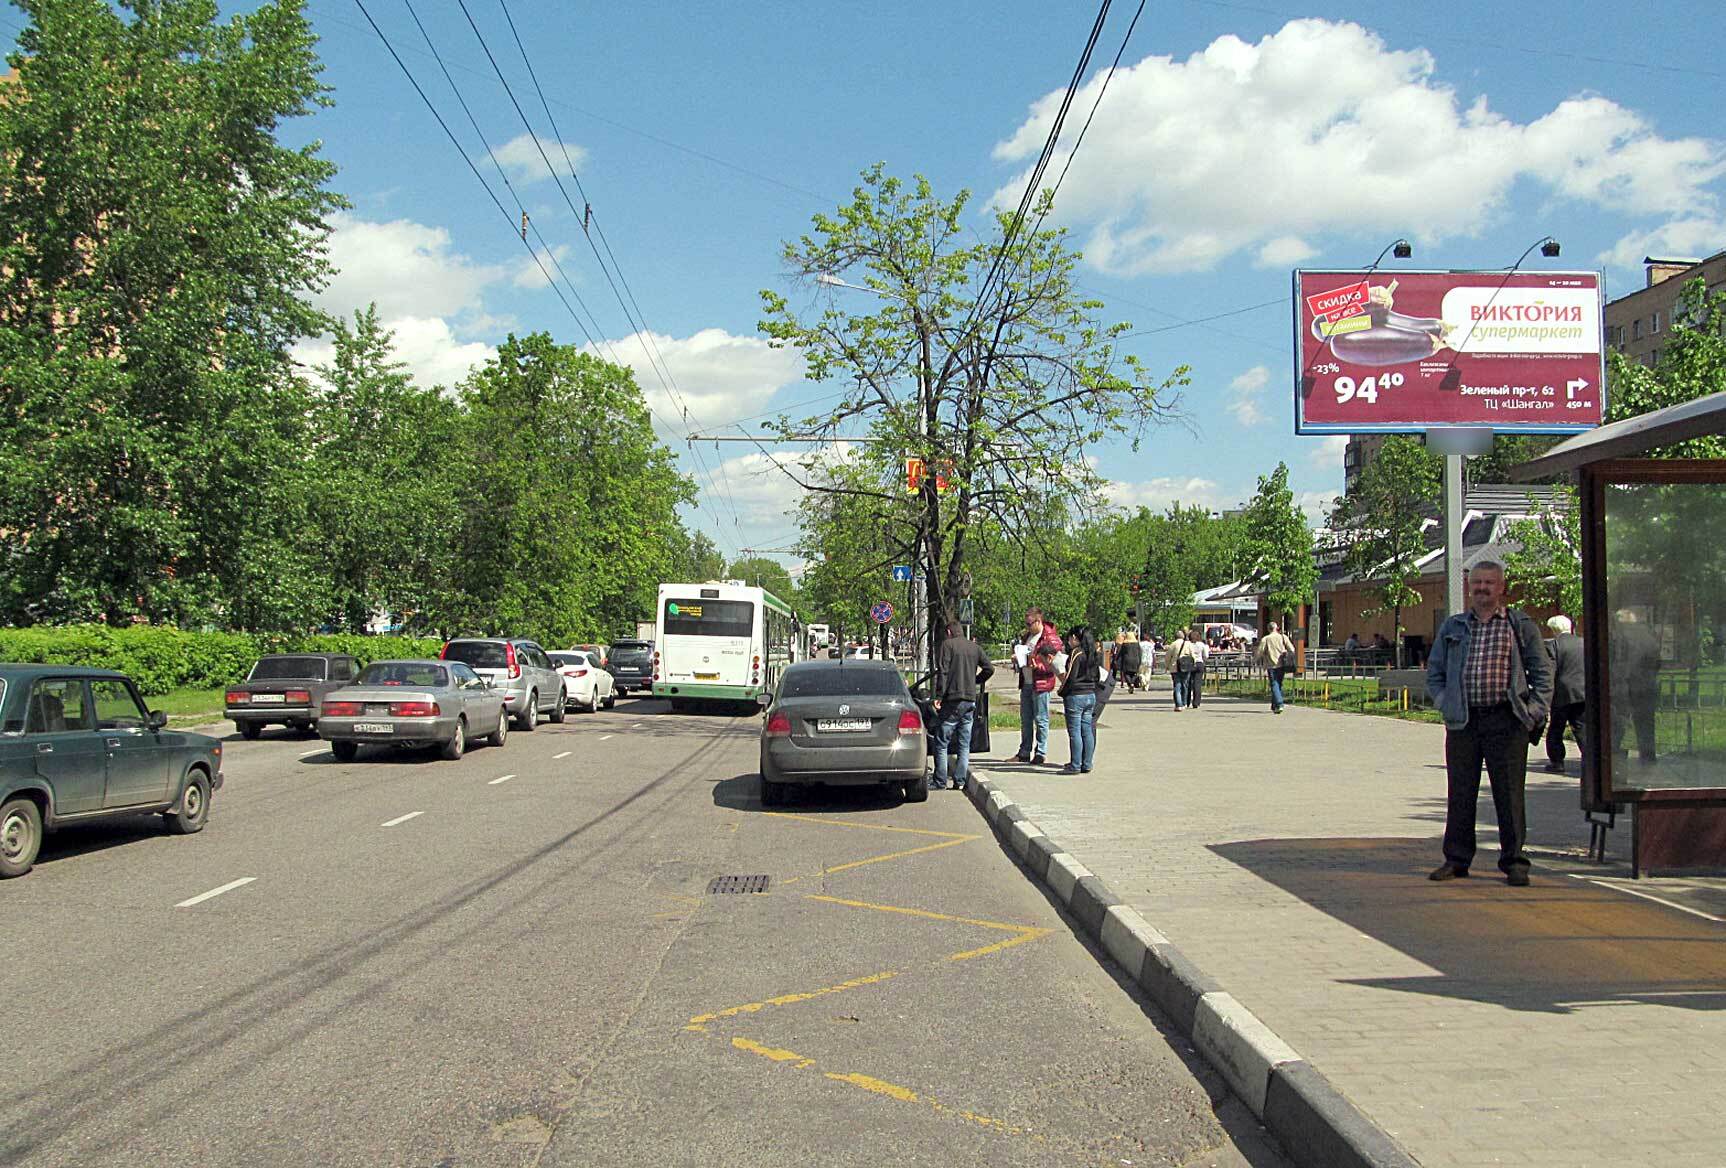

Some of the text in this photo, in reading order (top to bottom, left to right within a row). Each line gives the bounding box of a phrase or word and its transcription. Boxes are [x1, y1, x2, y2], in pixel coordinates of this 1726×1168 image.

[1470, 304, 1582, 322] ВИКТОРИЯ
[1470, 324, 1583, 342] супермаркет
[1312, 362, 1340, 375] -23%
[1460, 384, 1555, 398] Зеленый пр-т, 62
[1484, 398, 1499, 411] ТЦ
[1566, 401, 1582, 409] 450
